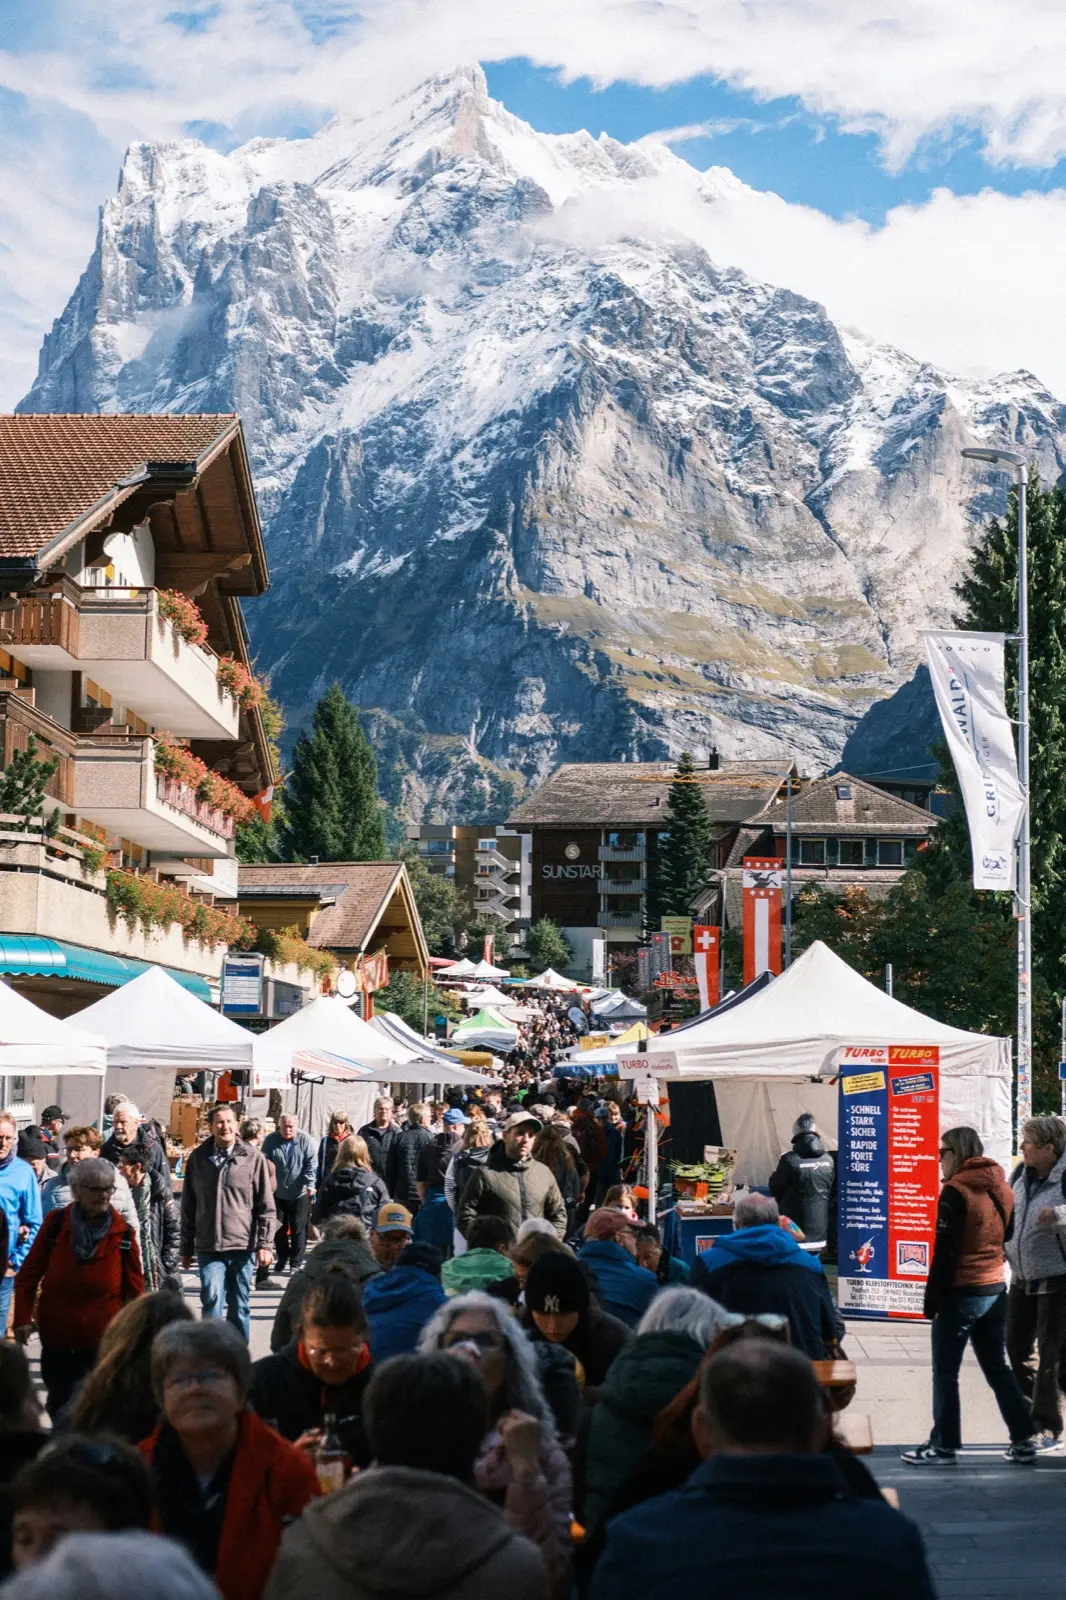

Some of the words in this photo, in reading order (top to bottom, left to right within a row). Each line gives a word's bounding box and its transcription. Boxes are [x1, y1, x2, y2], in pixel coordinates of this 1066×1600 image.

[542, 864, 602, 878] SUNSTAR
[844, 1047, 885, 1058] TURBO
[891, 1048, 933, 1059] TURBO
[620, 1060, 649, 1070] TURBO
[850, 1105, 882, 1115] SCHNELL
[850, 1116, 874, 1126] STARK
[850, 1127, 876, 1137] SICHER
[850, 1140, 878, 1150] RAPIDE
[850, 1152, 874, 1161] FORTE
[850, 1161, 870, 1172] SÛRE
[865, 1280, 914, 1289] KLEBSTOFFTECHNIK
[544, 1294, 560, 1312] NY
